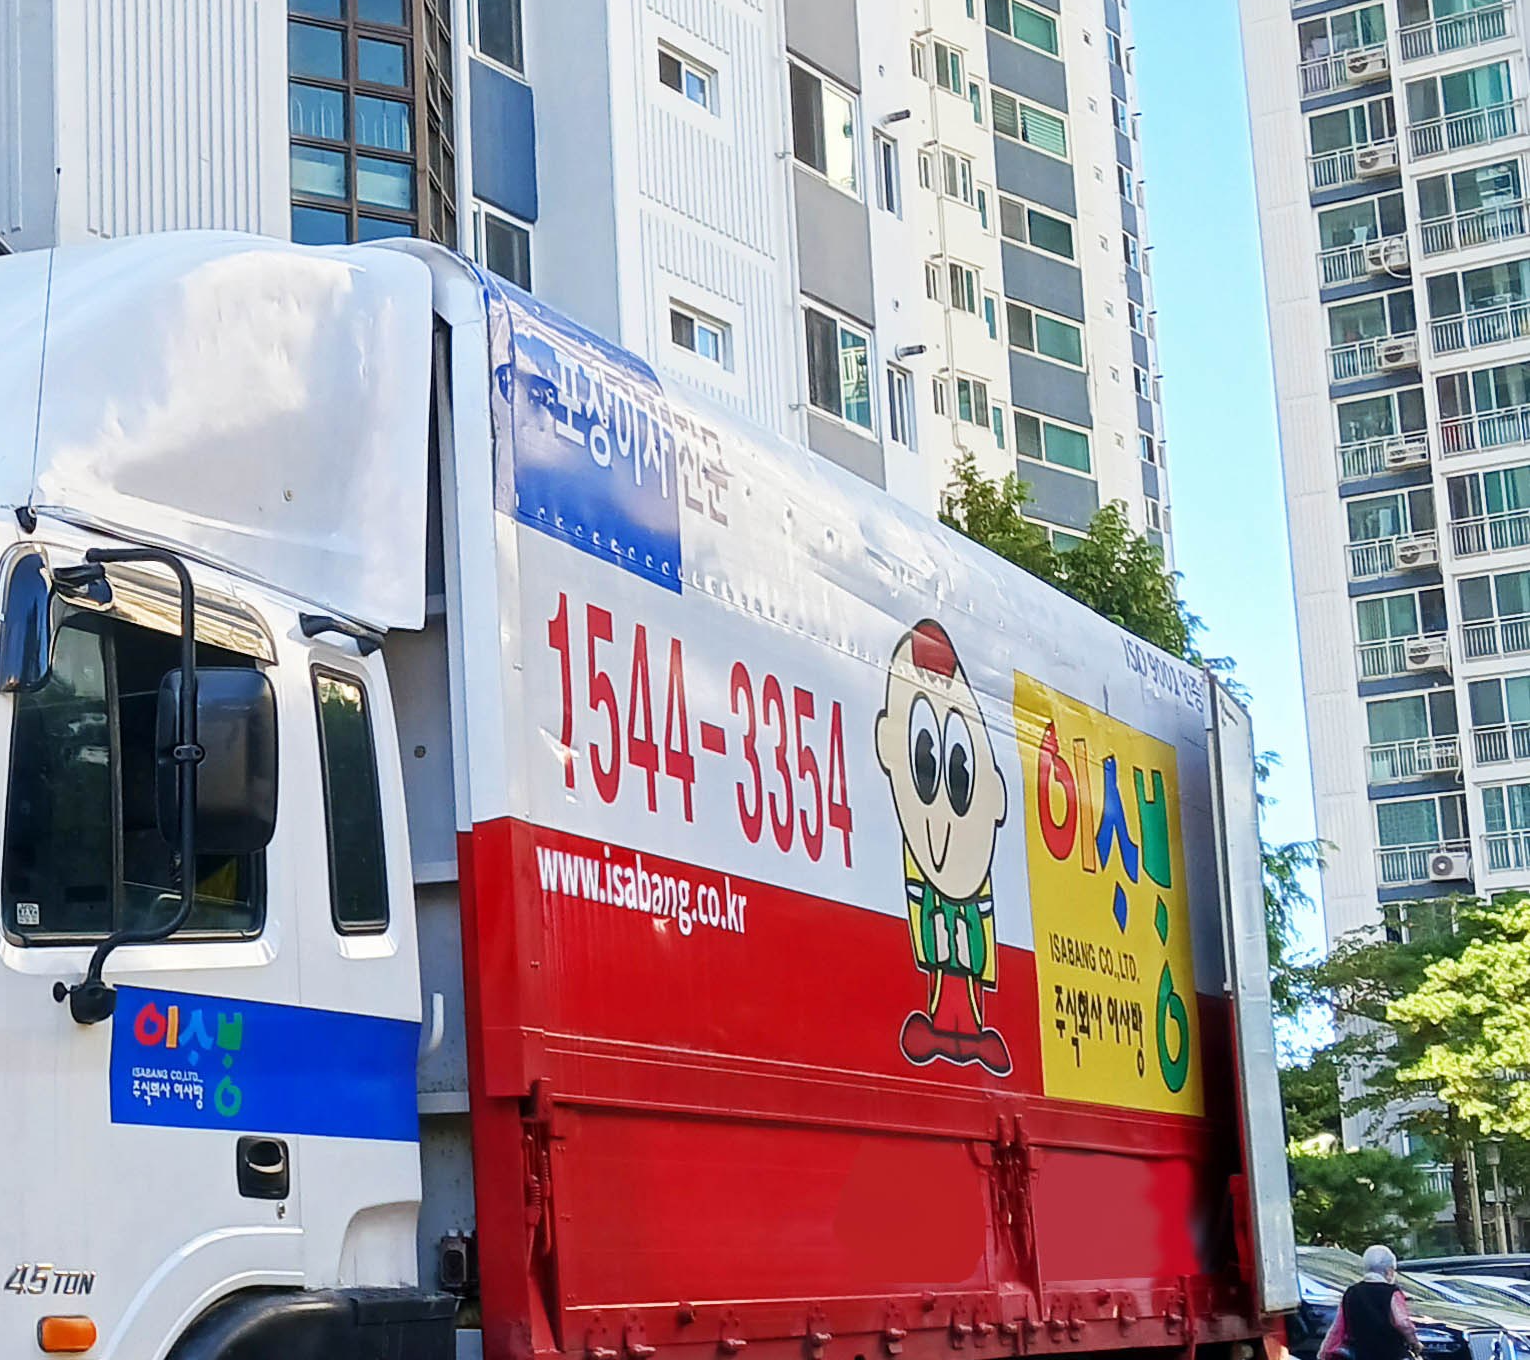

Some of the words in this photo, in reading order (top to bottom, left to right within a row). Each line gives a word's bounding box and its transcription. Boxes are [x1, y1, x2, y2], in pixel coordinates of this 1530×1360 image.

[1120, 635, 1147, 677] ISO
[1147, 651, 1181, 697] 9001
[548, 591, 854, 869] 1544-3354
[536, 844, 748, 936] www.isabang.co.kr
[1037, 719, 1189, 1093] 이사방
[1048, 931, 1097, 972] ISABANG
[1098, 946, 1141, 985] CO.,LTD.
[133, 1001, 243, 1118] 이사방
[1054, 984, 1103, 1068] 주식회사
[1106, 995, 1146, 1079] 이사방
[132, 1080, 171, 1107] 주식회사
[173, 1083, 204, 1110] 이사방
